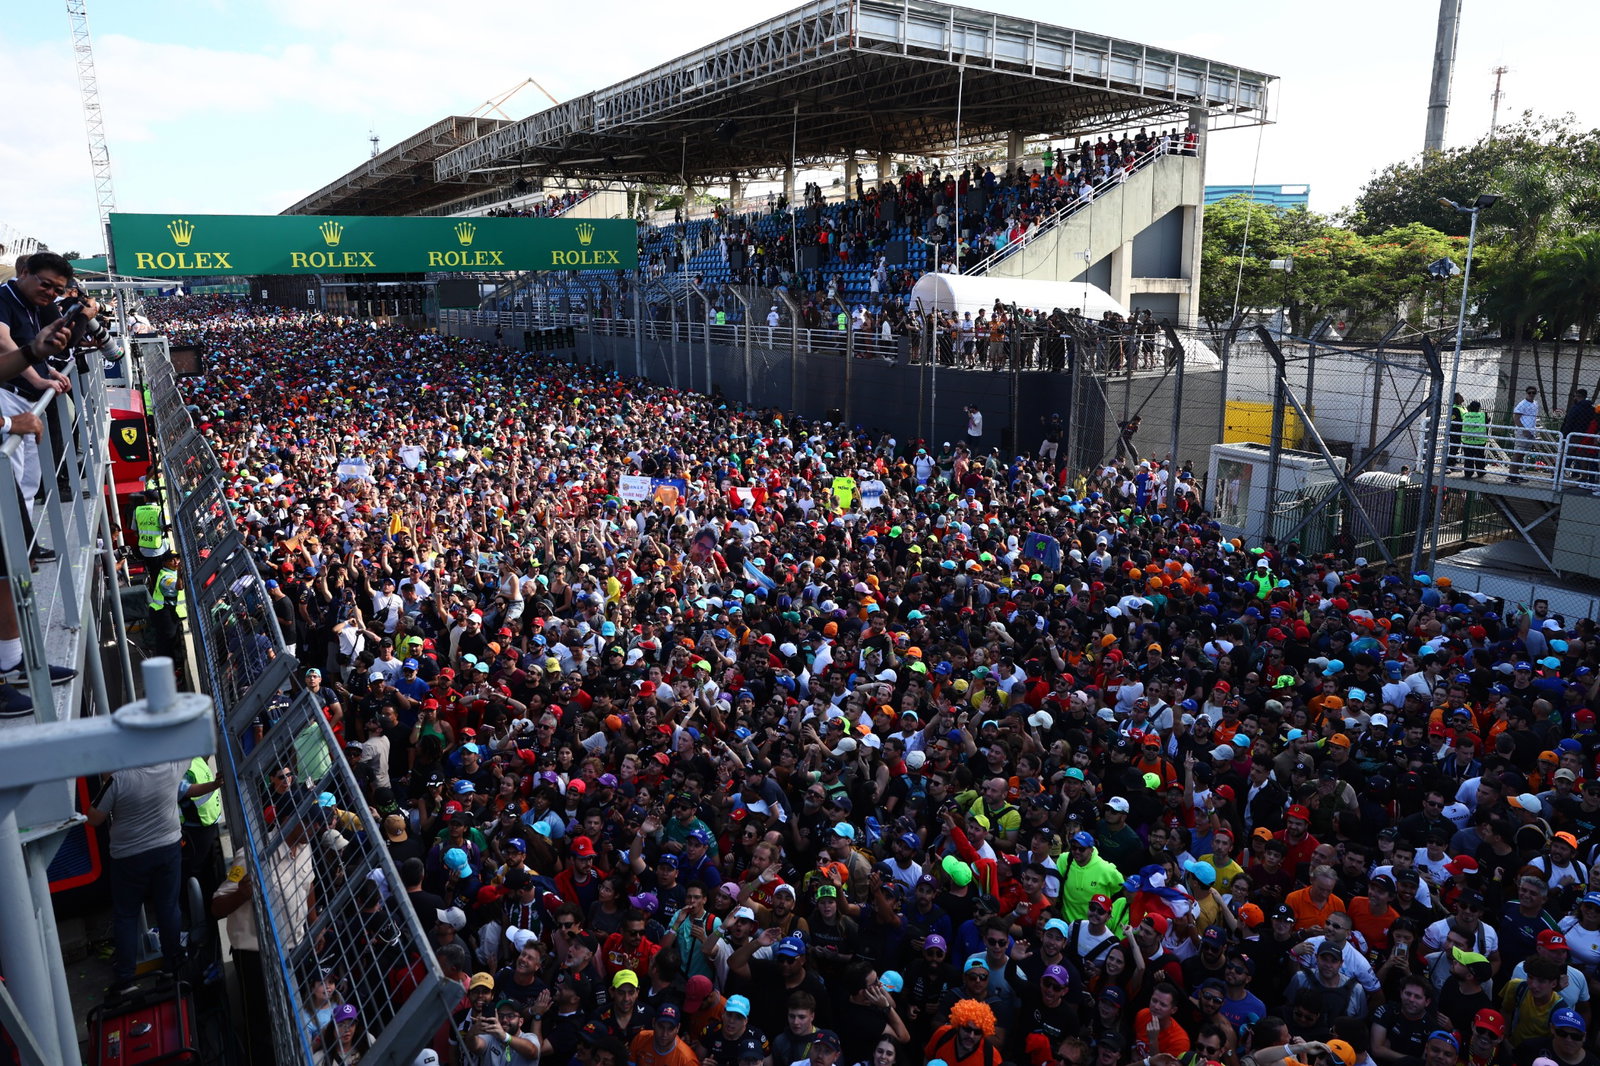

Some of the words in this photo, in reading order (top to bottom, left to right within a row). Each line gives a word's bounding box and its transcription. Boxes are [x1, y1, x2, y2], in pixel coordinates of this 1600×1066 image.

[135, 252, 233, 269] ROLEX
[290, 251, 376, 268] ROLEX
[428, 250, 505, 266] ROLEX
[551, 250, 620, 265] ROLEX
